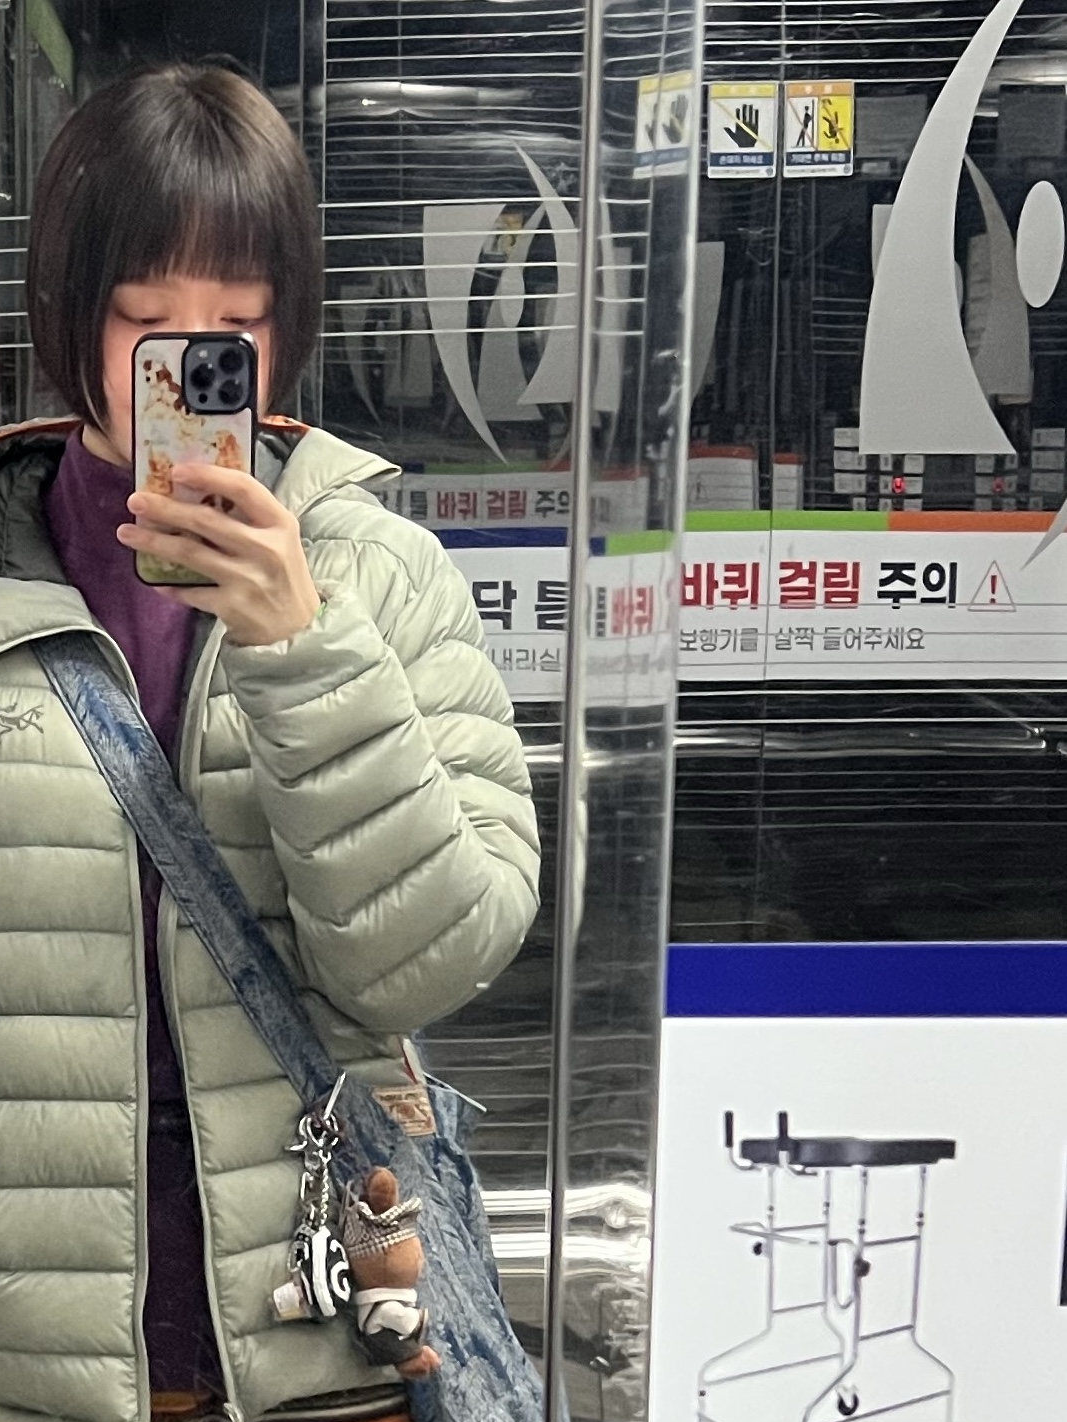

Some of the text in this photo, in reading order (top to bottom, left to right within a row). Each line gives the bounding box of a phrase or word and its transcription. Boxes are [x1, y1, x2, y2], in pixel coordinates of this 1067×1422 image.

[437, 490, 478, 521] 바퀴
[487, 490, 528, 520] 걸림
[679, 560, 958, 609] 바퀴 걸림 주의
[679, 626, 926, 652] 보행기를 살짝 들어주세요
